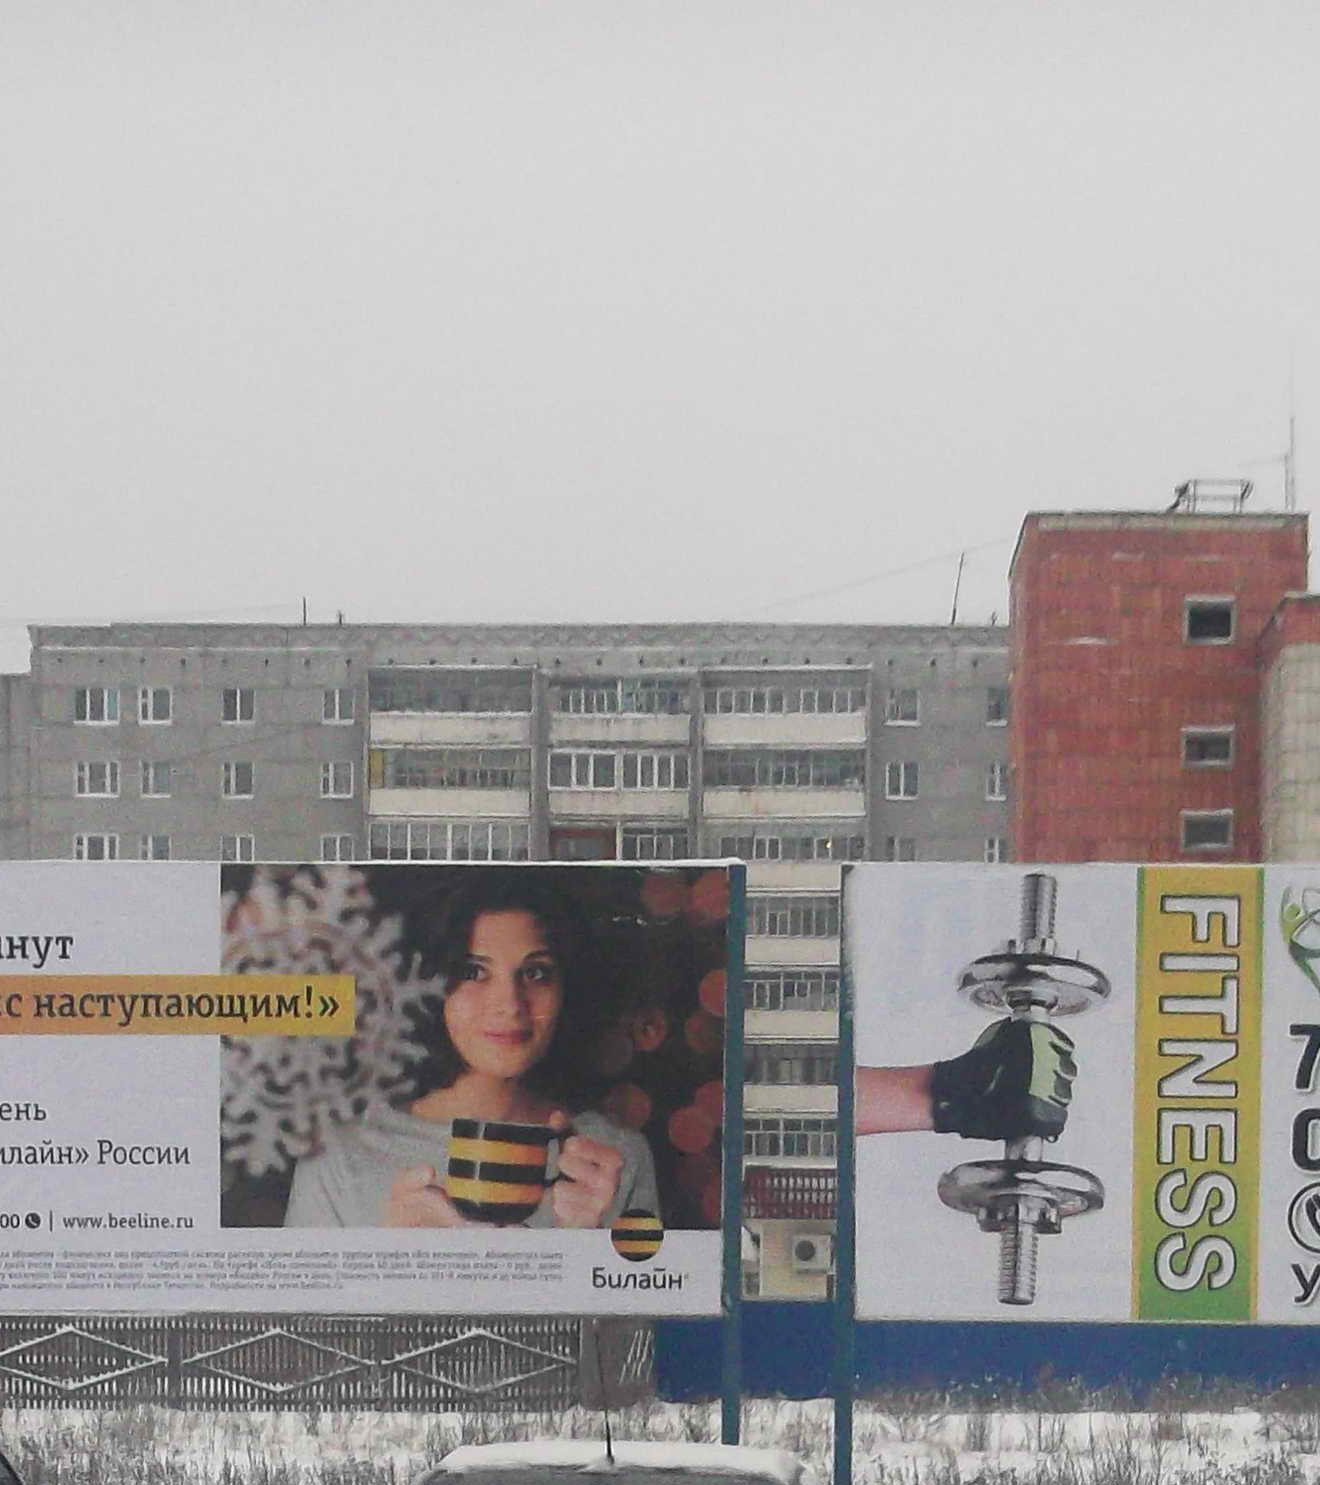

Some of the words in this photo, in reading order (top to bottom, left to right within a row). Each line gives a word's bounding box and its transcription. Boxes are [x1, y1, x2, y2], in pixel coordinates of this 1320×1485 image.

[32, 984, 340, 1027] наступающим!»
[1154, 894, 1242, 1291] FITNESS
[96, 1138, 191, 1166] России
[62, 1211, 195, 1230] www.beeline.ru
[591, 1266, 683, 1291] Билайн
